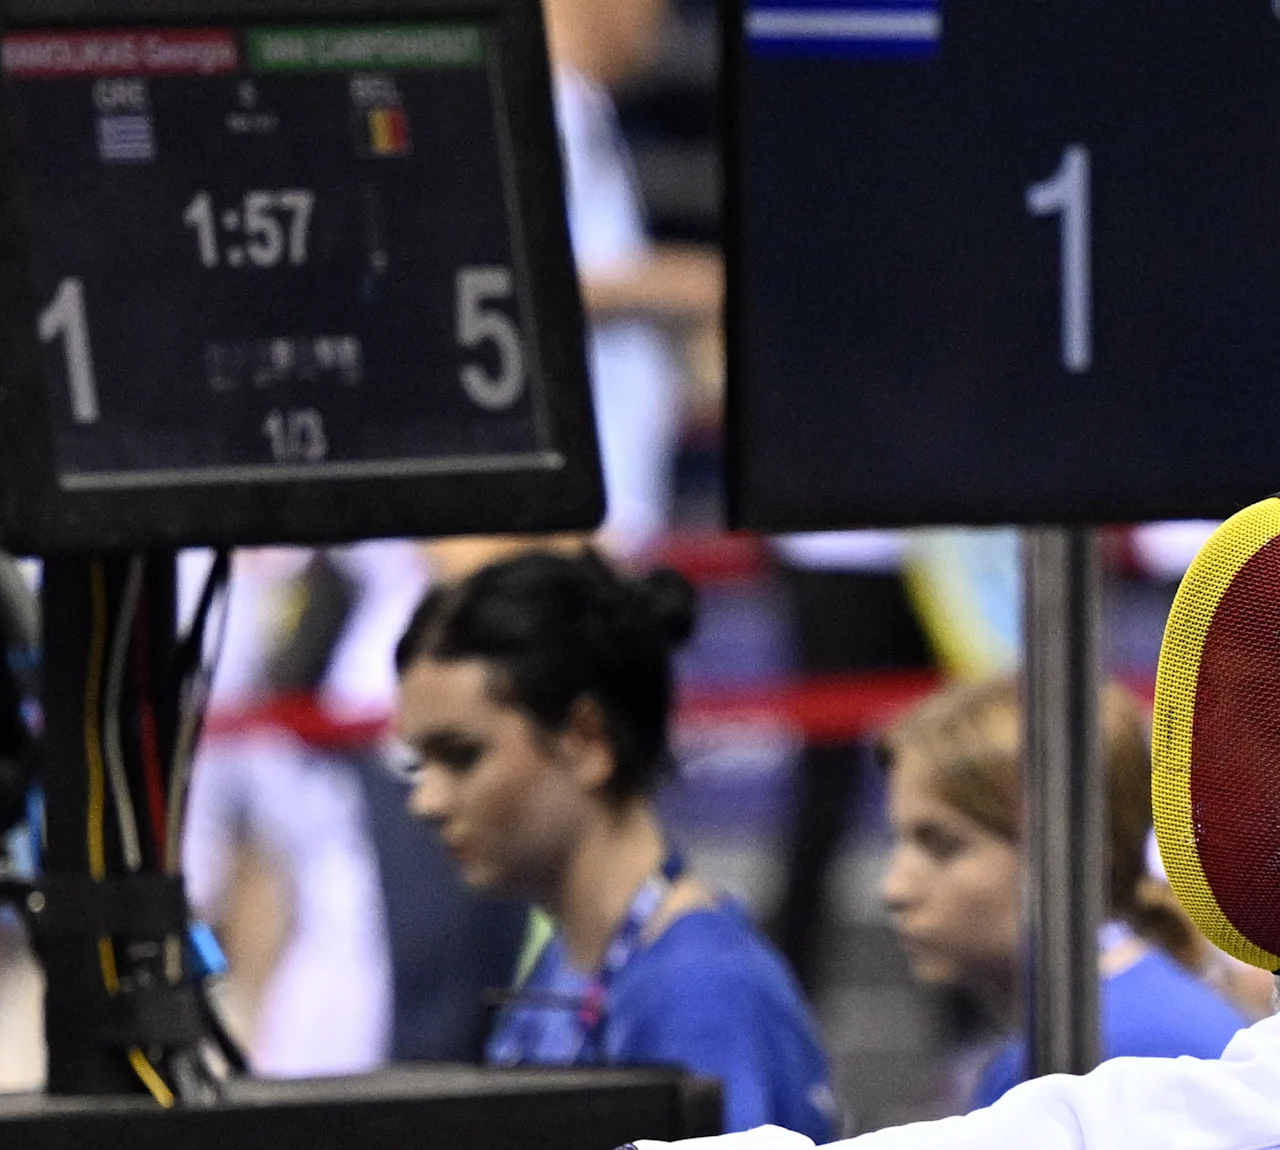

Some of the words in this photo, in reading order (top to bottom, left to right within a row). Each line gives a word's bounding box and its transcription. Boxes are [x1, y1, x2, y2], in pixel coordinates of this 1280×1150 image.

[183, 189, 314, 268] 1:57
[1026, 143, 1093, 373] 1
[37, 276, 99, 424] 1
[454, 264, 523, 410] 5
